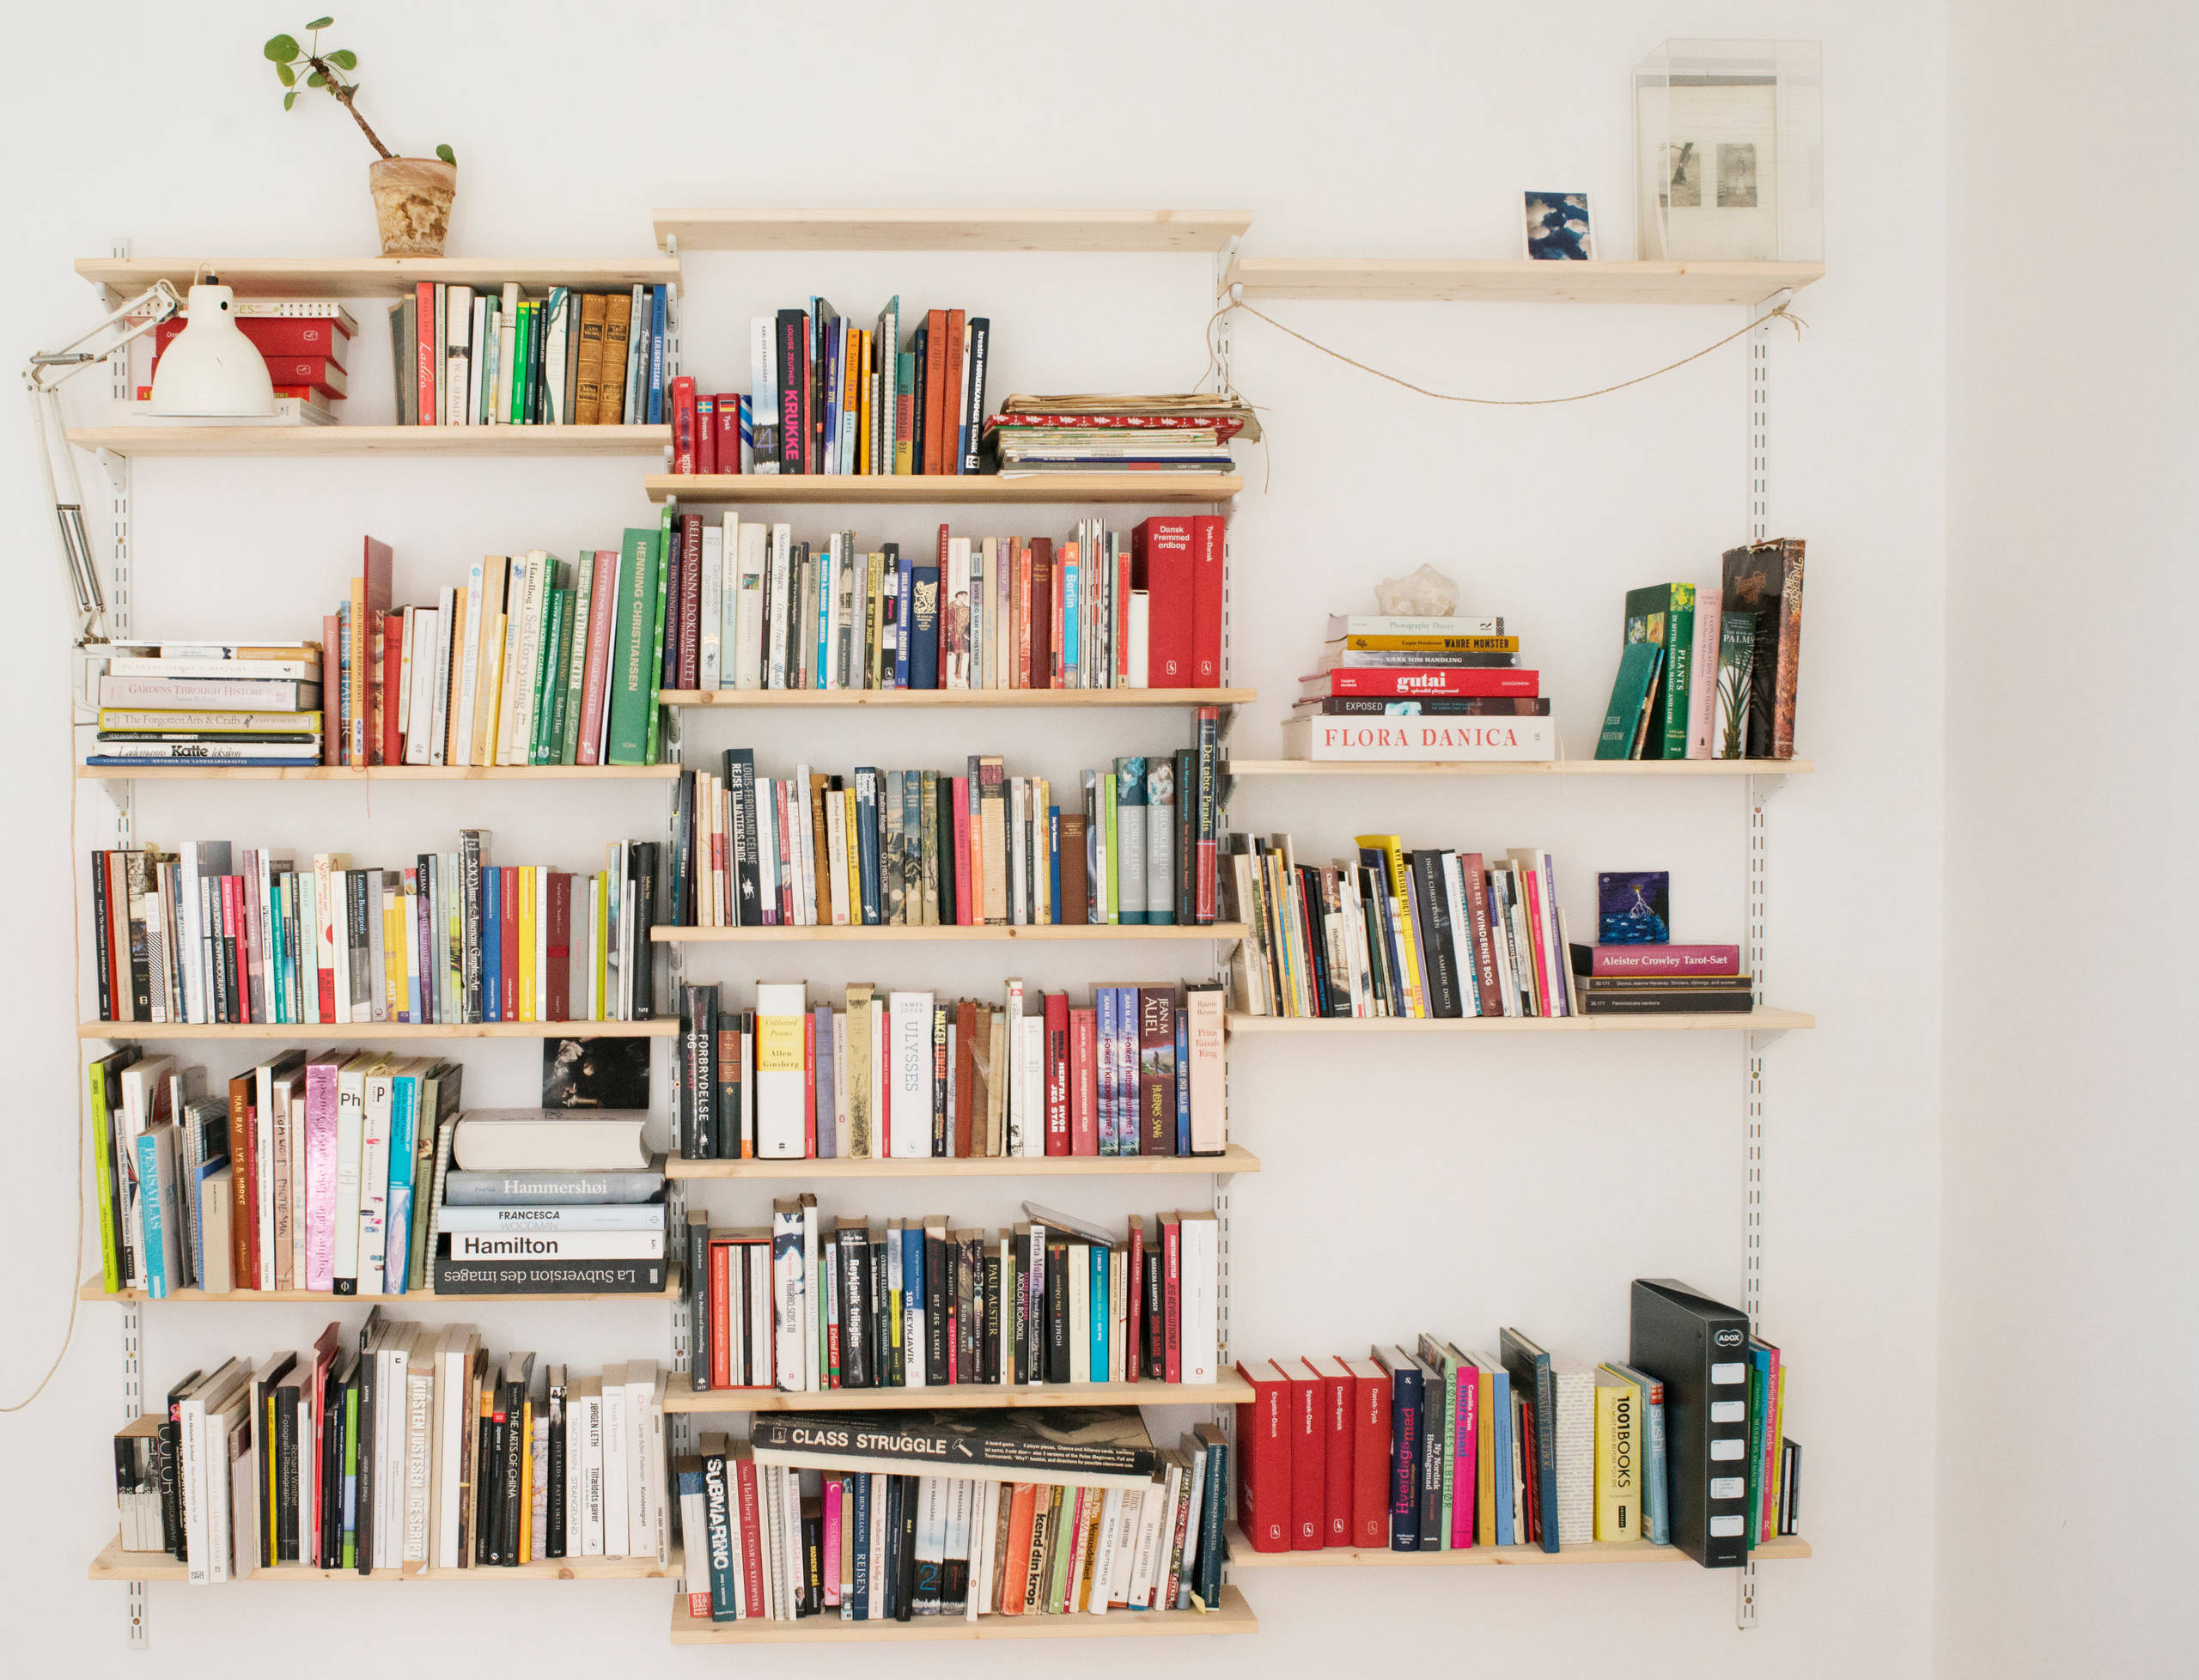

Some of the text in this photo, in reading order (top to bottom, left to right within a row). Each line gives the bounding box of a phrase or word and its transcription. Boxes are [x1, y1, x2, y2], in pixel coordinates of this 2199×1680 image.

[976, 331, 985, 358] kreativ
[418, 342, 434, 388] Ladies
[784, 390, 798, 460] KRUKKE
[971, 423, 979, 453] TEKNIK
[527, 563, 538, 604] Handbog
[685, 520, 698, 683] BELLADONNA DOKUMENTET
[1066, 575, 1076, 607] Berlin
[1784, 577, 1793, 597] BOG
[628, 541, 646, 691] HENNING CHRISTIANSEN
[1445, 639, 1508, 648] WAHRE MONSTER
[1722, 635, 1753, 643] PALMS
[515, 613, 538, 709] Selvforsyning
[1677, 649, 1685, 691] PLANTS
[129, 685, 262, 697] GARDENS THROUGH HISTORY
[1397, 673, 1446, 693] gutai
[124, 715, 141, 724] The
[143, 715, 184, 726] Forgotten
[186, 715, 204, 725] Arts
[216, 716, 241, 725] Crafts
[1325, 729, 1518, 746] FLORA DANICA
[172, 745, 208, 757] Katte
[732, 764, 741, 788] REJSE
[1203, 766, 1212, 791] tabte
[743, 764, 757, 865] LOUIS-FERDINAND CÉLINE
[1202, 795, 1211, 831] Paradis
[467, 858, 477, 881] 200
[357, 899, 366, 934] Bourgeois
[1428, 881, 1440, 928] CHRISTENSEN
[1438, 955, 1447, 986] SAMLEDE
[1476, 910, 1489, 964] KVINDERNES
[1483, 967, 1493, 986] BOG
[1603, 956, 1640, 965] Aleister
[1642, 956, 1680, 966] Crowley
[1146, 996, 1157, 1036] AUEL
[1159, 998, 1168, 1034] JEAN M
[687, 1034, 697, 1049] OG
[905, 1021, 918, 1092] ULYSSES
[934, 1010, 946, 1079] NAKED LUNCH
[699, 1034, 708, 1121] FORBRYDELSE
[1124, 1070, 1133, 1127] klippehulerne
[1152, 1085, 1162, 1138] HULERNES SANG
[235, 1147, 244, 1161] LYS
[144, 1147, 159, 1229] PENISATLAS
[236, 1178, 246, 1204] MØRKE
[504, 1180, 606, 1194] Hammershøi
[499, 1211, 559, 1220] FRANCESCA
[502, 1221, 557, 1230] WOODMAN
[465, 1237, 558, 1255] Hamilton
[444, 1269, 635, 1282] La Subversion des images
[848, 1260, 860, 1347] Reykjavik trilogien
[989, 1294, 997, 1336] AUSTER
[590, 1403, 599, 1427] JØRGEN
[1651, 1409, 1666, 1452] sushi
[508, 1410, 519, 1498] THE ARTS OF CHINA
[590, 1430, 599, 1446] LETH
[792, 1429, 947, 1455] CLASS STRUGGLE
[1434, 1444, 1441, 1455] Ny
[1443, 1373, 1456, 1508] GRØNLYKKES TILBEHØR
[1458, 1427, 1467, 1457] mad
[408, 1381, 425, 1558] KIRSTEN JUSTESEN ICE SCRIPT
[1396, 1408, 1414, 1515] Hverdagsmad
[590, 1467, 599, 1501] Tilfældets
[638, 1486, 647, 1526] Kvindetegnet
[706, 1459, 728, 1570] SUBMARINO
[1026, 1513, 1046, 1605] kend din krop
[1082, 1501, 1100, 1581] Nin Venusdeltaet
[856, 1554, 866, 1594] REJSEN
